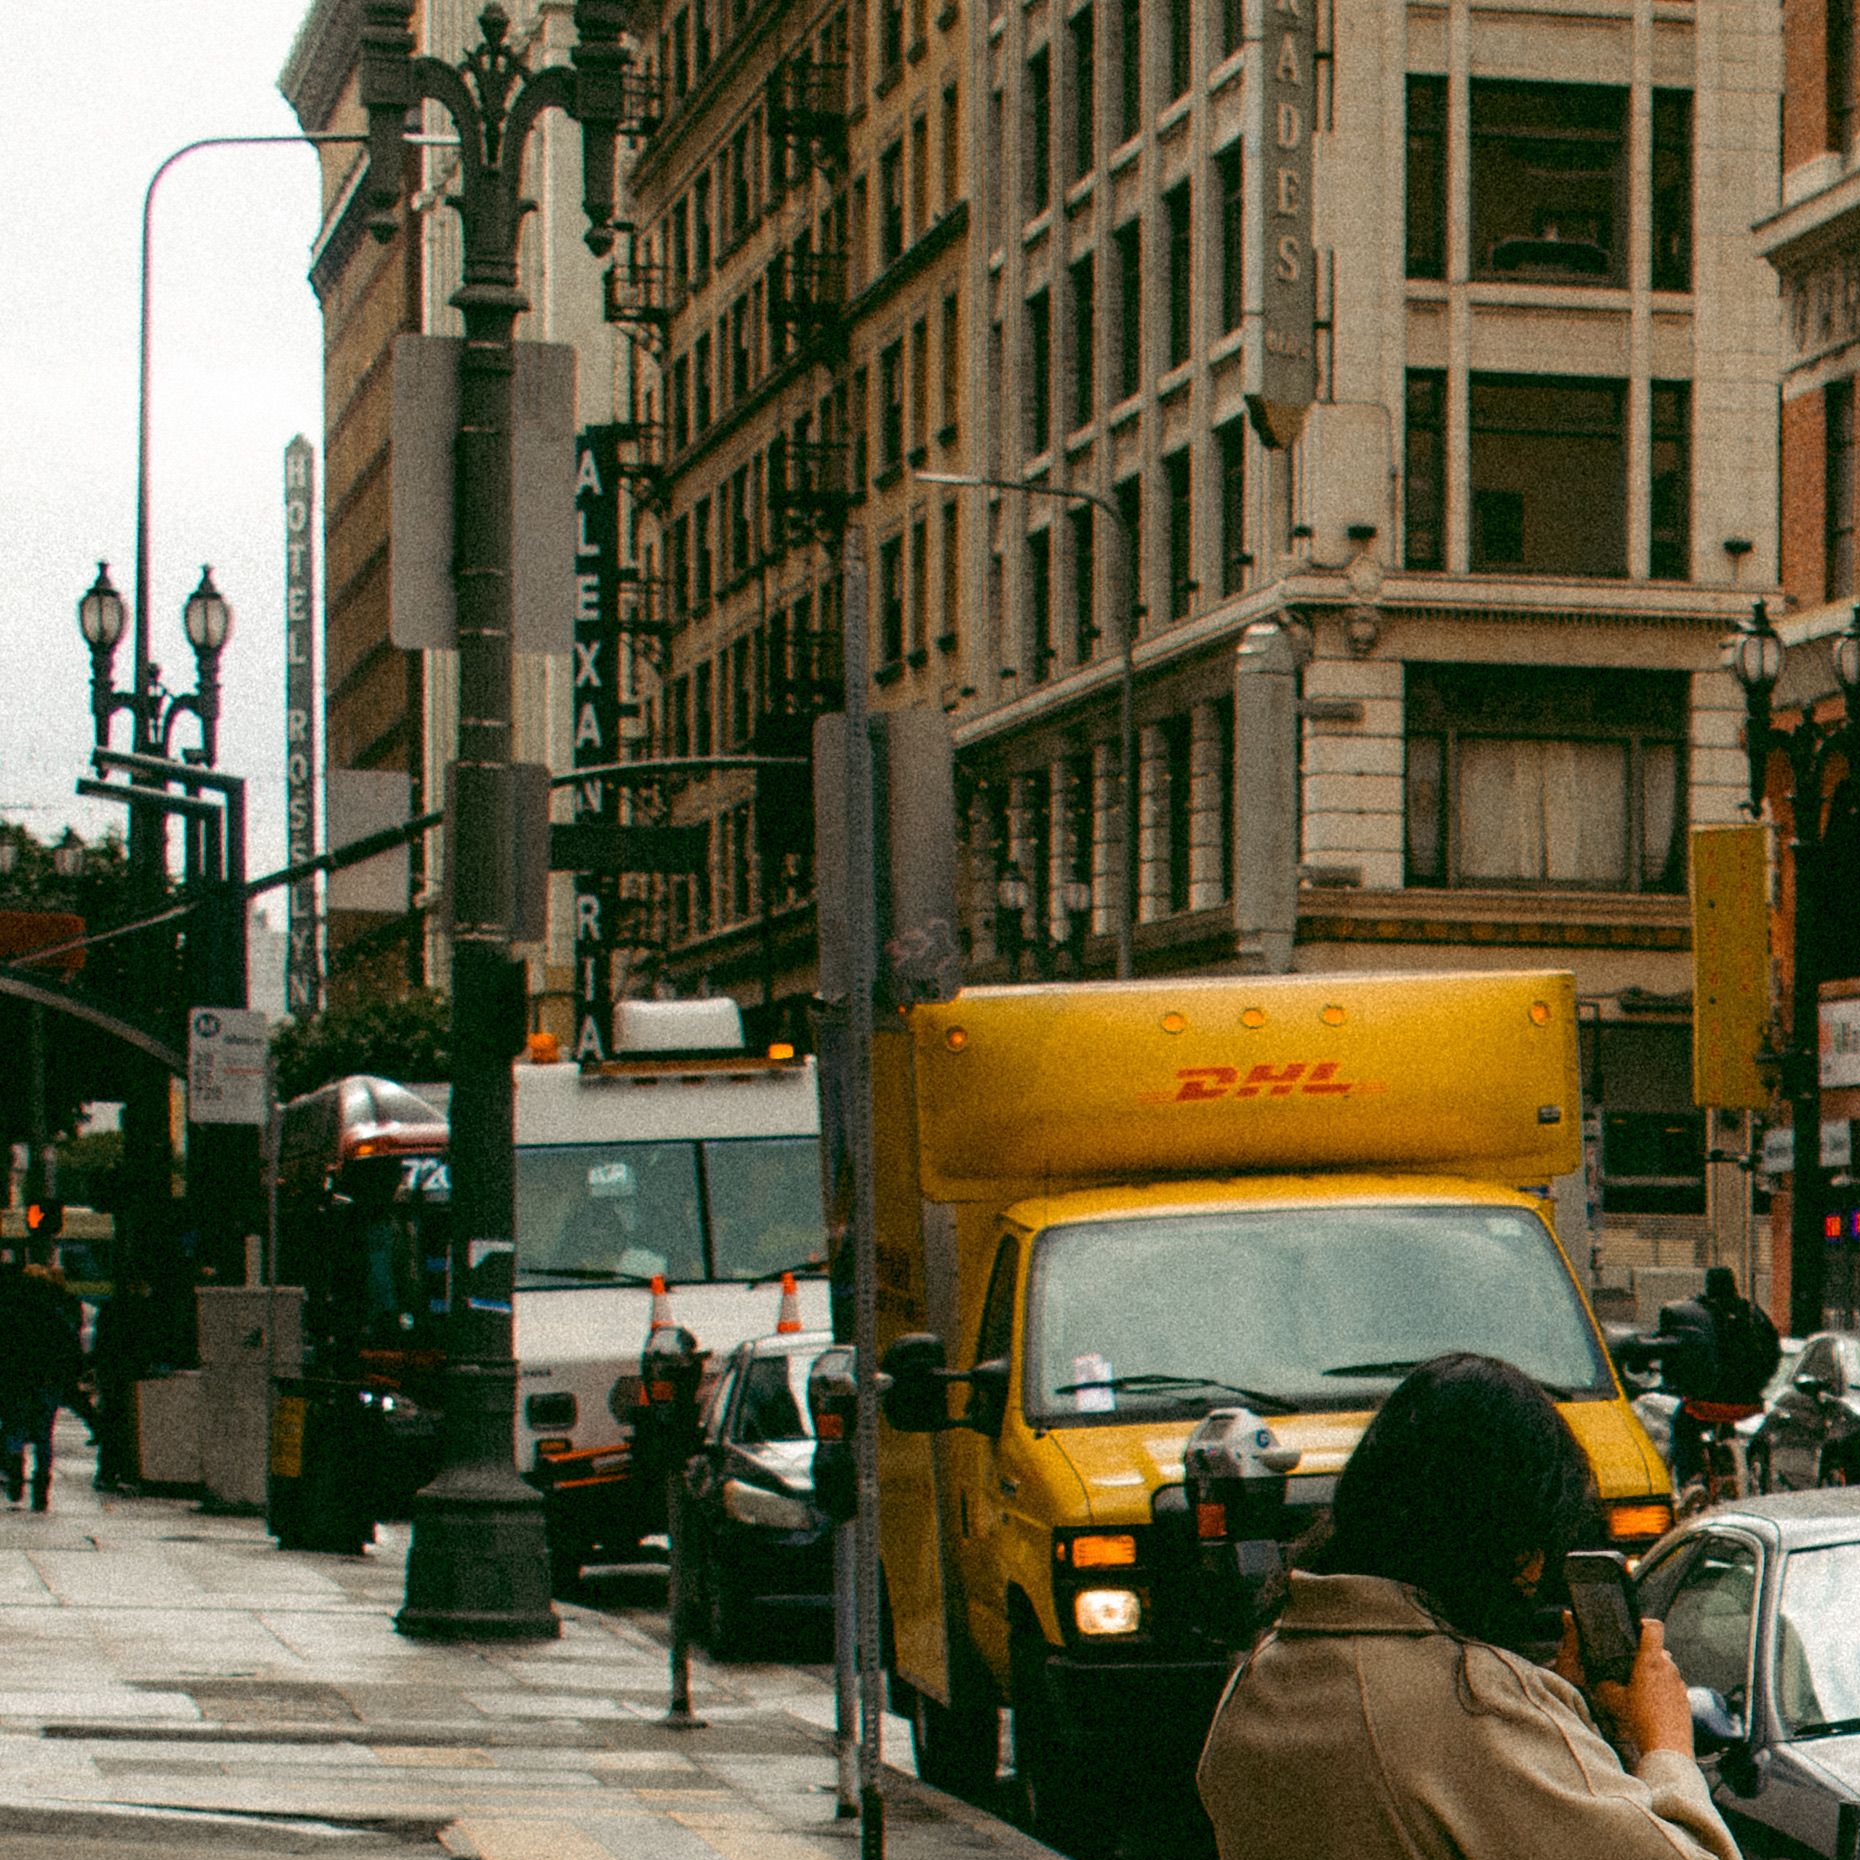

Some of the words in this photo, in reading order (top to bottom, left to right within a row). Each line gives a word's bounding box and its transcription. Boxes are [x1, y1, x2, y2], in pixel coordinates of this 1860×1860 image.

[287, 452, 309, 664] HOTEL
[573, 447, 604, 1062] ALEXANRIA
[1176, 1062, 1353, 1103] DHL
